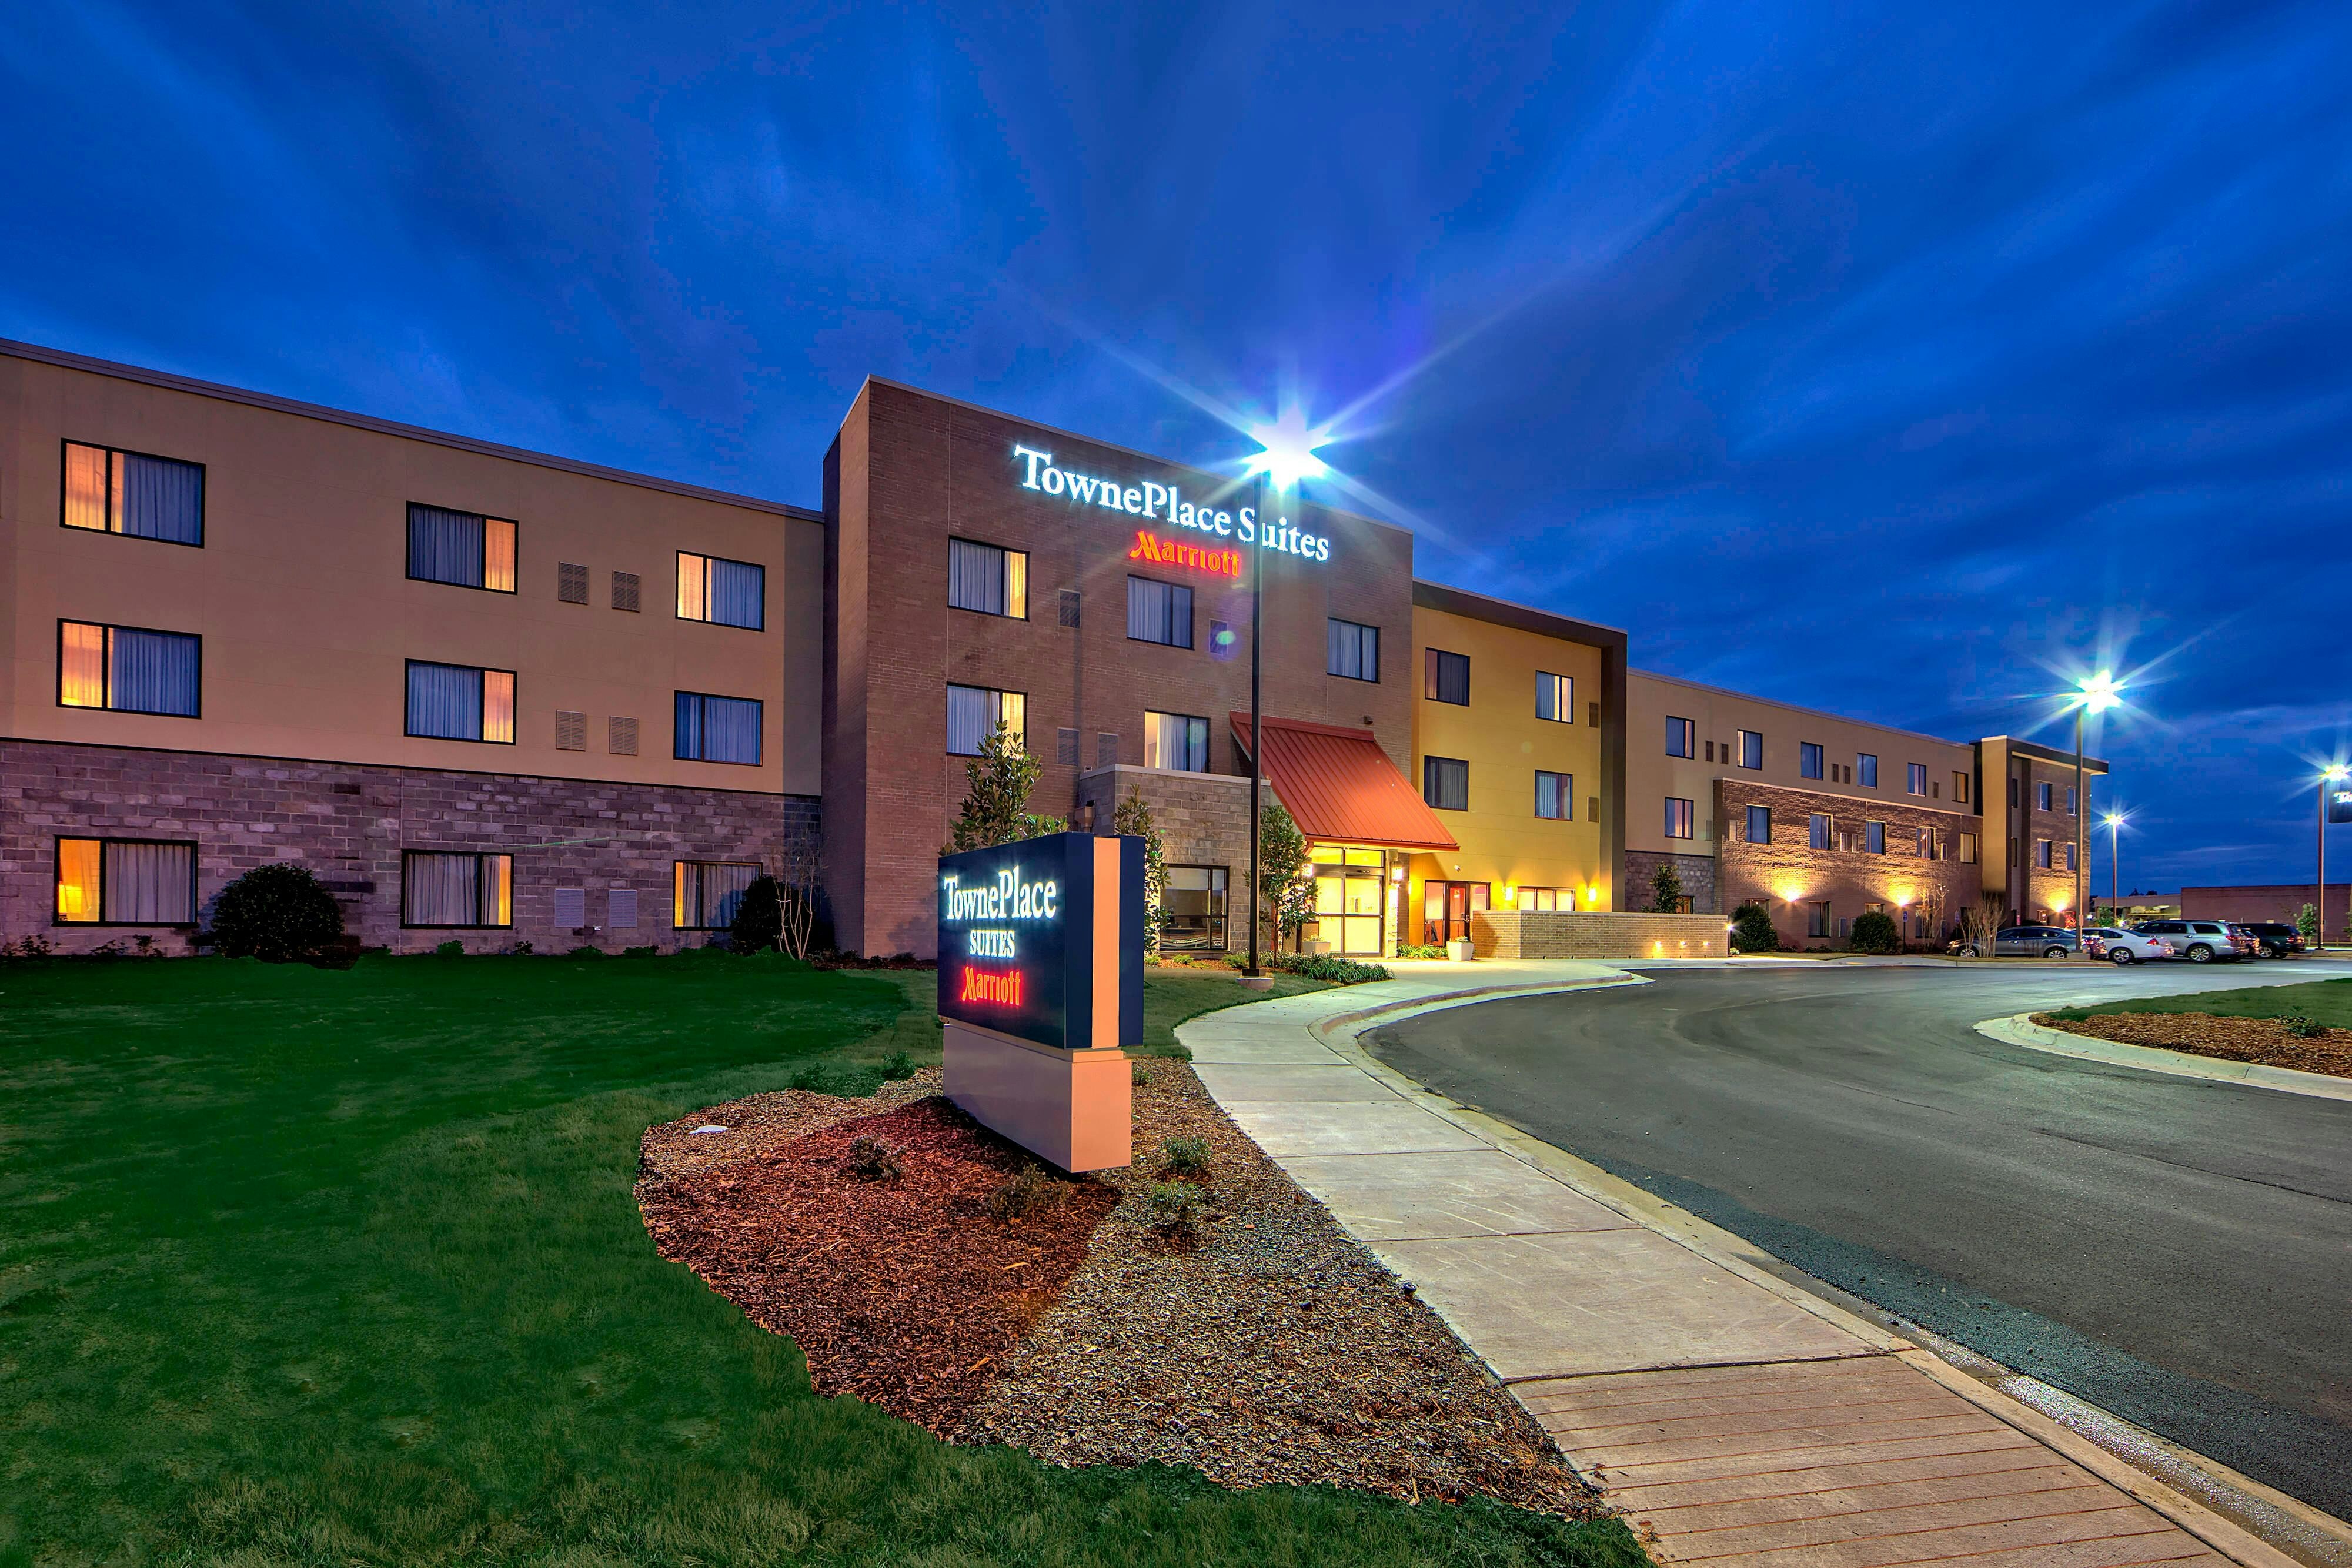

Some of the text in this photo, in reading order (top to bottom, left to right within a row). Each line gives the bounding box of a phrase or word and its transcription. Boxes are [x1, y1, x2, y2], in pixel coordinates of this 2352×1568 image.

[1014, 444, 1329, 561] TownePlace Suites
[1130, 530, 1240, 576] Marriott
[944, 865, 1057, 920] TownePlace
[970, 929, 1015, 959] SUITES
[961, 966, 1021, 1006] Marriott
